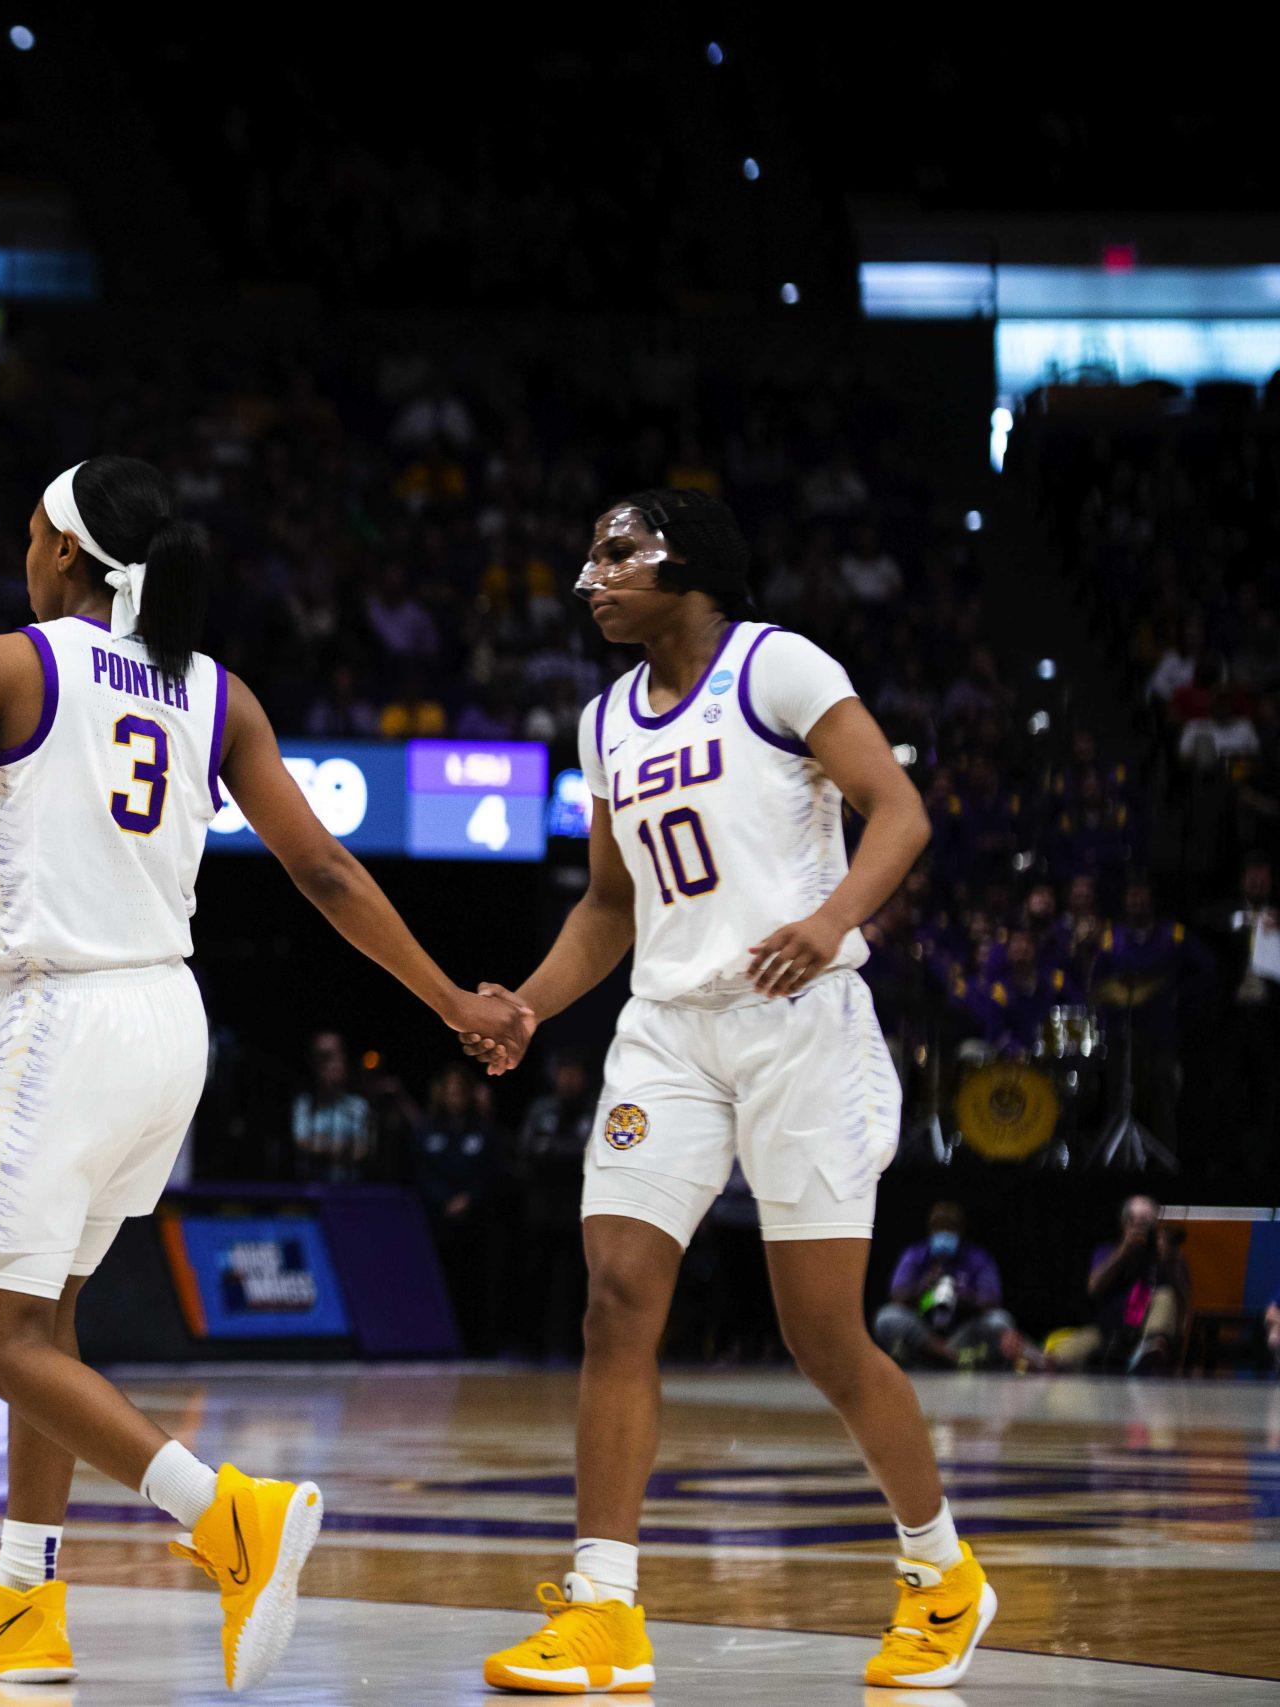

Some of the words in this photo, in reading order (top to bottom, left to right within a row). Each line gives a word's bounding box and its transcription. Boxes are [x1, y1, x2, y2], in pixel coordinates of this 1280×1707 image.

[91, 646, 190, 712] POINTER
[109, 712, 171, 838] 3
[613, 737, 724, 815] LSU
[466, 794, 510, 851] 4
[637, 805, 721, 906] 10
